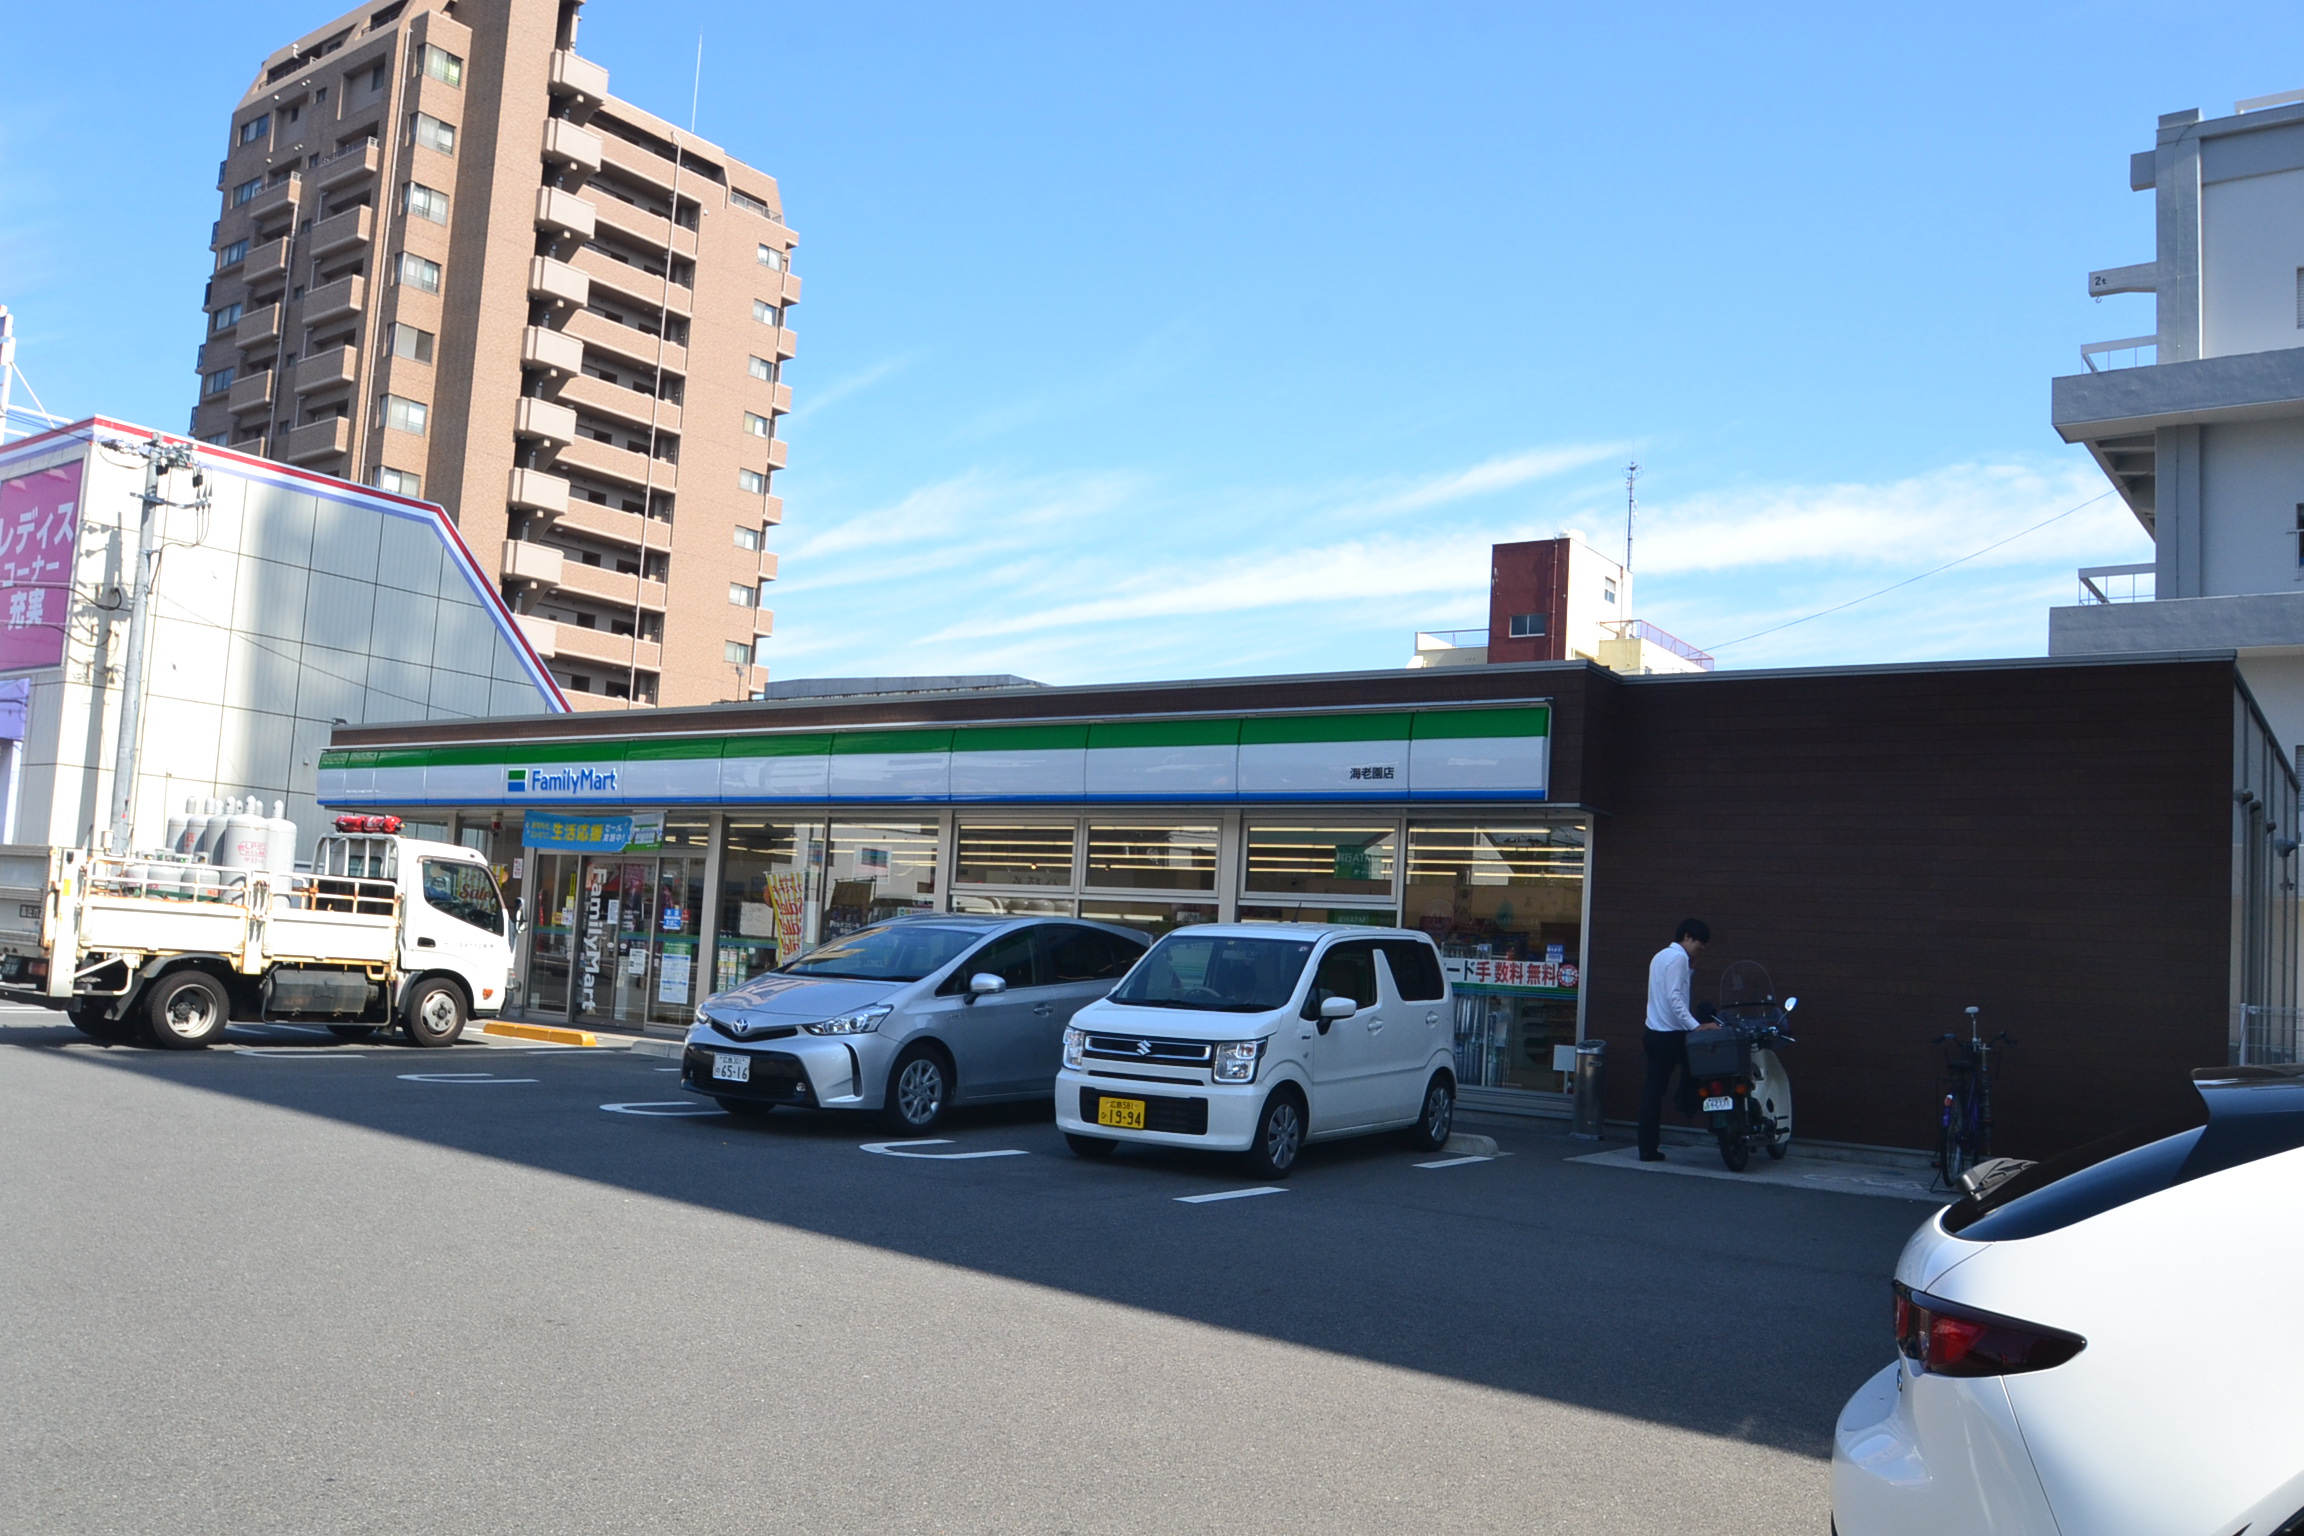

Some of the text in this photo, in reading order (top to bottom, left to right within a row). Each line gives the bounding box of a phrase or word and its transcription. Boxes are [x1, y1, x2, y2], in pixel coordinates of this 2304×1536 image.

[0, 501, 75, 557] レディス
[2, 554, 60, 587] コーナー
[7, 588, 46, 631] 充実
[531, 768, 618, 794] FamilyMart
[1350, 767, 1395, 780] 海老園店
[551, 821, 605, 842] 生活応援
[582, 868, 607, 1011] FamilyMart
[1444, 959, 1556, 987] ード手数料無料
[721, 1065, 748, 1080] 65-16
[1109, 1109, 1142, 1127] 19-94
